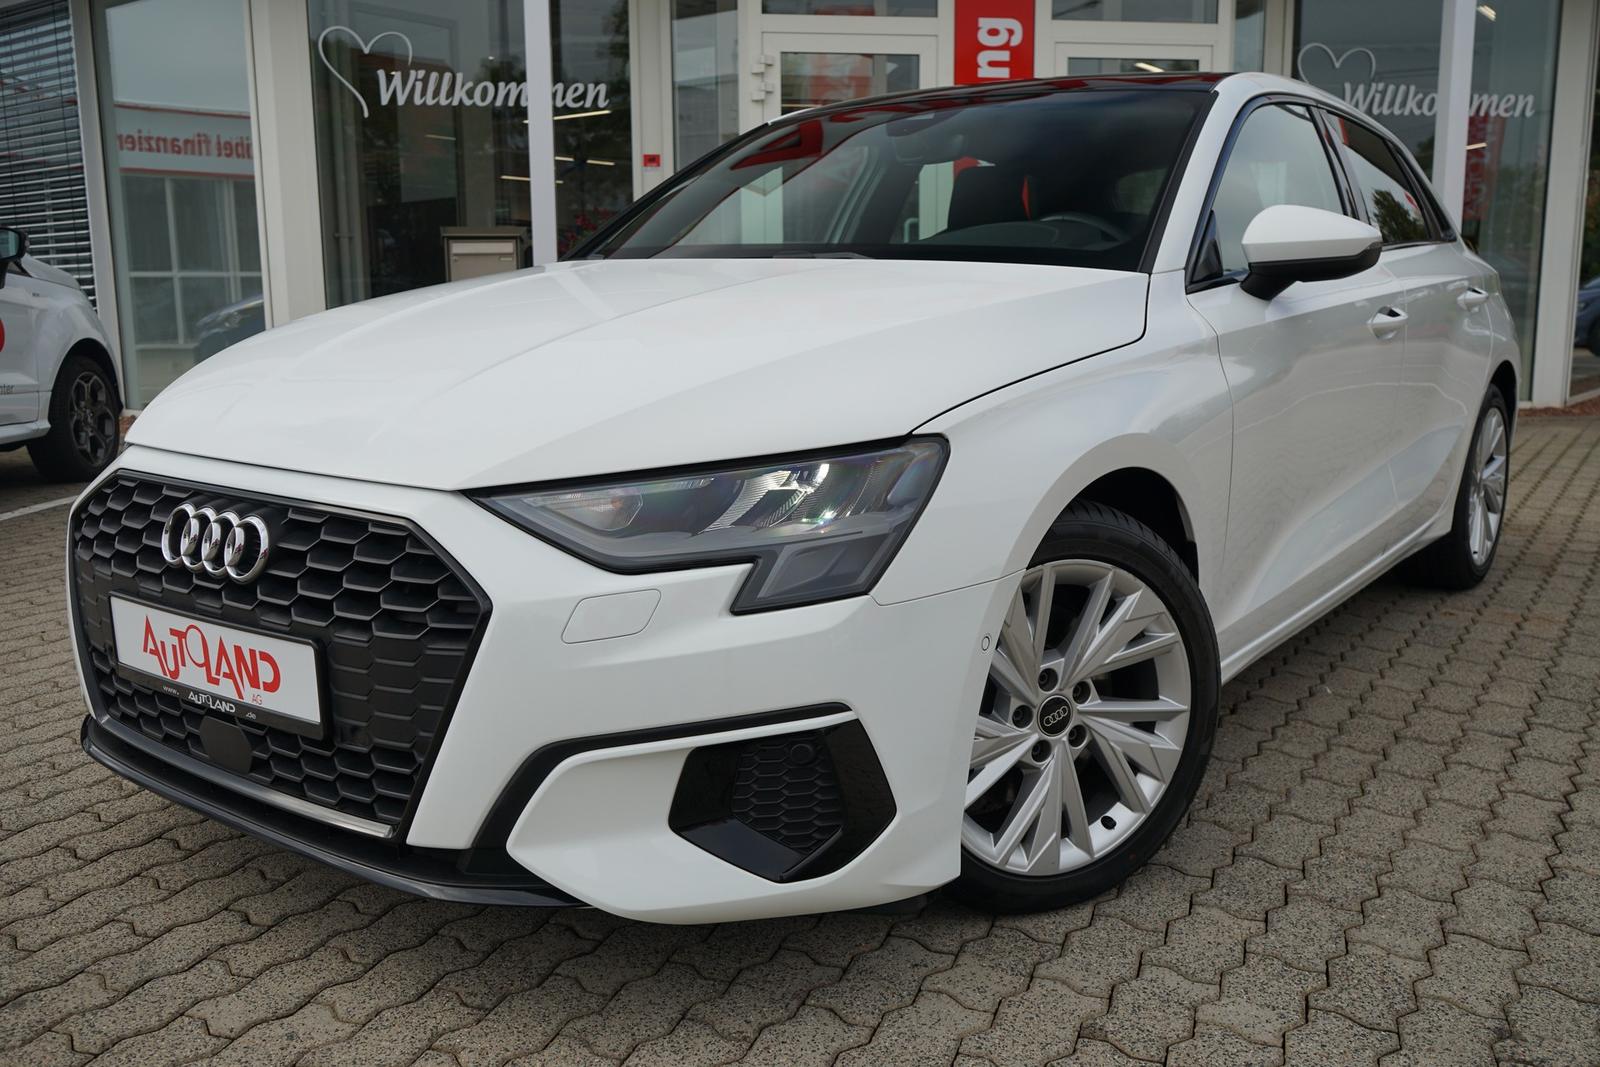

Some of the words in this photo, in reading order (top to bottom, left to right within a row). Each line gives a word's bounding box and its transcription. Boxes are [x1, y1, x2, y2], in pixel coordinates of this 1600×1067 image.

[1344, 82, 1535, 118] Willkomen
[143, 615, 281, 701] AUTOLAND
[188, 690, 236, 713] AUTOLAND
